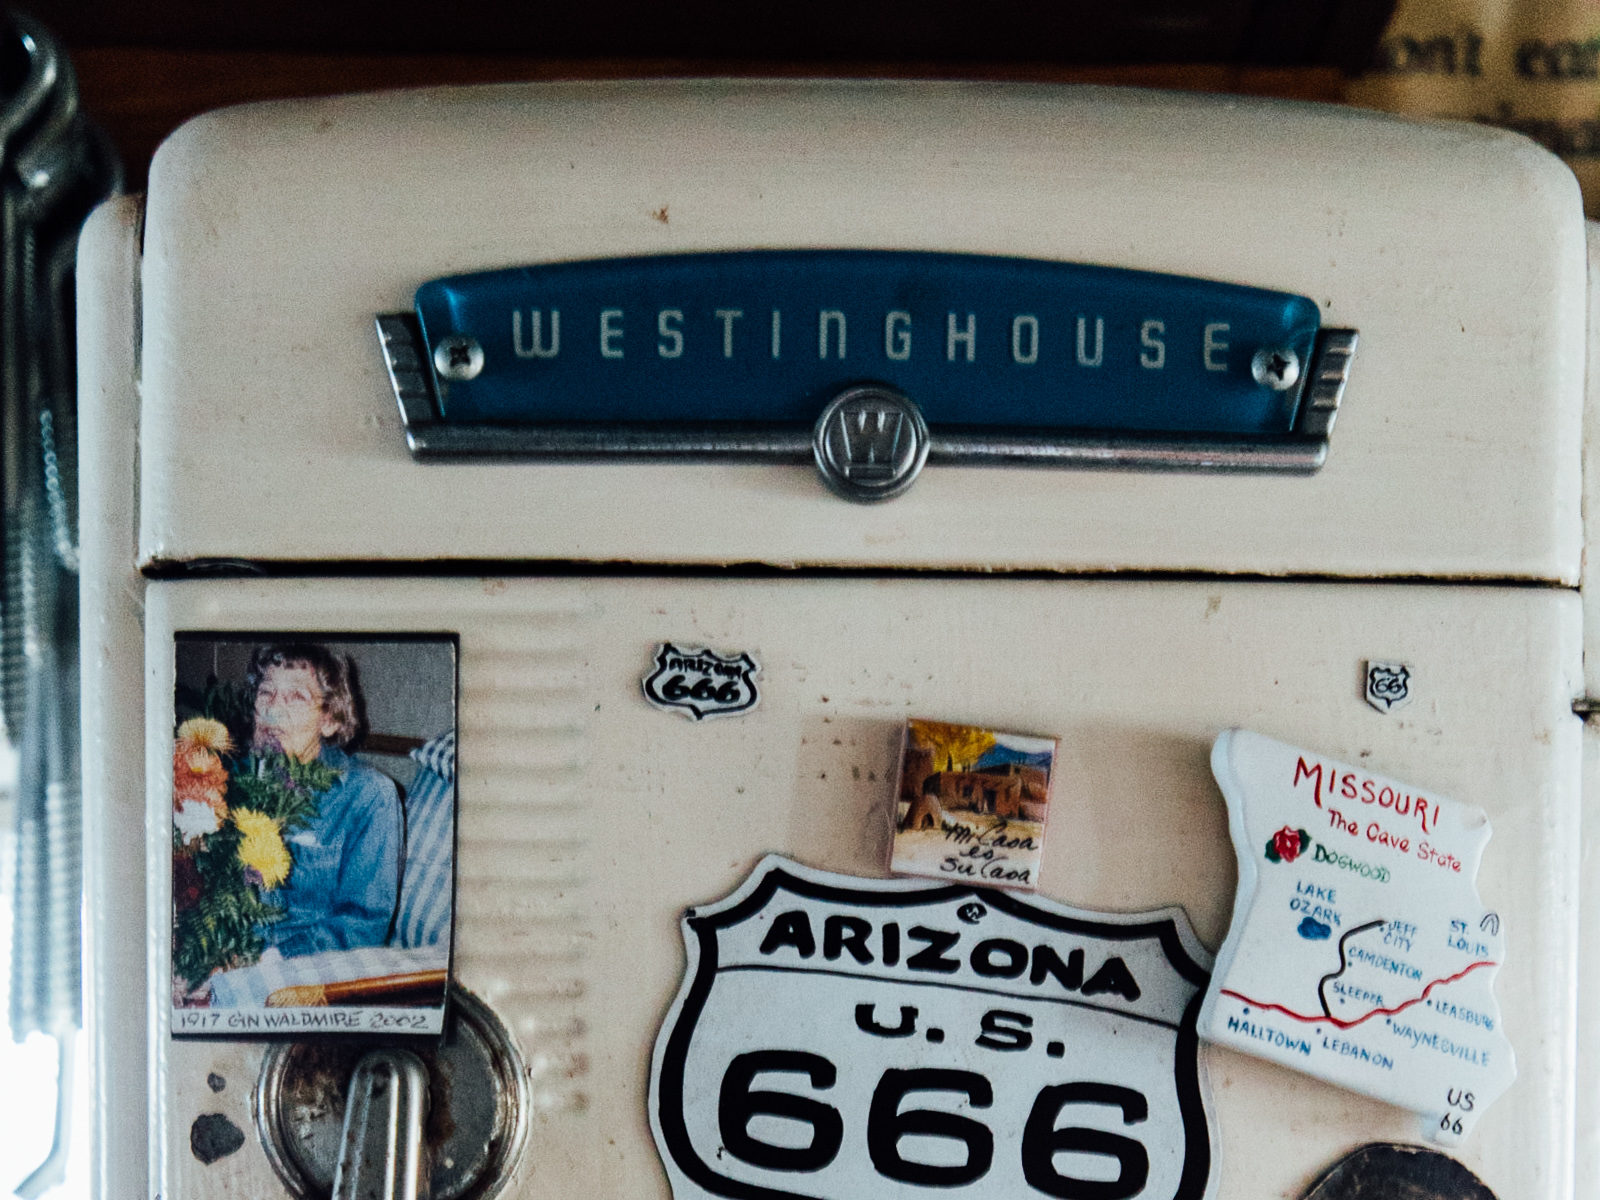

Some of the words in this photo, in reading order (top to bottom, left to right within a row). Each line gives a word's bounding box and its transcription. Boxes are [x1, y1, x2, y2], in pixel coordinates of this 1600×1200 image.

[511, 309, 1232, 372] WESTINGHOUSE
[662, 674, 741, 704] 666
[1375, 678, 1402, 694] 66
[1292, 755, 1441, 835] MISSOURI
[1328, 807, 1360, 837] The
[1366, 822, 1410, 854] Cave
[1416, 843, 1463, 873] State
[1296, 881, 1337, 904] LAKE
[1289, 898, 1342, 926] OZARK
[759, 909, 1142, 1001] ARIZONA
[1383, 932, 1413, 954] CITY
[1447, 935, 1489, 957] LOUIS
[1347, 946, 1424, 982] CAMDENTON
[180, 1014, 220, 1028] 1917
[263, 1010, 363, 1028] WALDMIRE
[1227, 1016, 1311, 1056] HALLTOWN
[1392, 1022, 1491, 1067] WAYNESVILLE
[1322, 1035, 1394, 1071] LEBANON
[1447, 1087, 1476, 1112] US
[1440, 1112, 1465, 1135] 66
